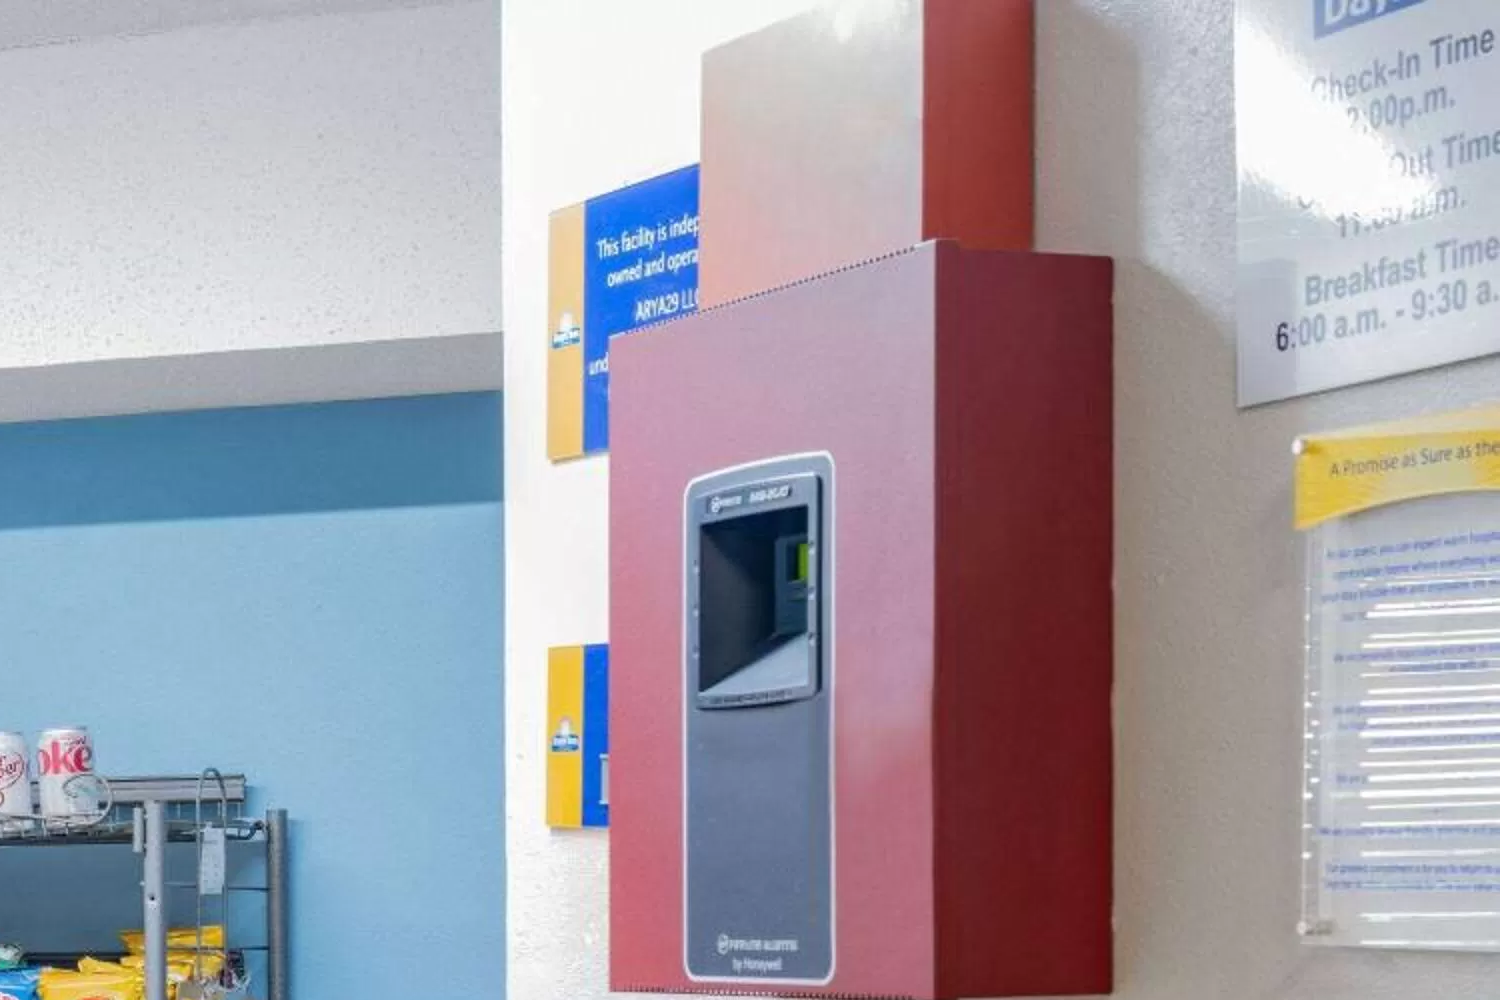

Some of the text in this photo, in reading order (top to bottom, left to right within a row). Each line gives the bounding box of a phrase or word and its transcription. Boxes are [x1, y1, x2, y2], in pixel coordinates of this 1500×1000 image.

[1429, 28, 1495, 69] Time
[1442, 130, 1500, 169] Time
[597, 238, 619, 260] This
[621, 226, 655, 253] facility
[657, 224, 667, 242] is
[607, 257, 643, 287] owned
[644, 252, 665, 277] and
[1305, 236, 1500, 306] Breakfast Time
[635, 292, 679, 322] ARYA29
[1276, 321, 1326, 351] 6:00
[1334, 308, 1387, 339] a.m.
[1412, 279, 1467, 320] 9:30
[1330, 462, 1339, 478] A
[1402, 453, 1417, 468] as
[1421, 446, 1453, 466] Sure
[1455, 445, 1471, 460] as
